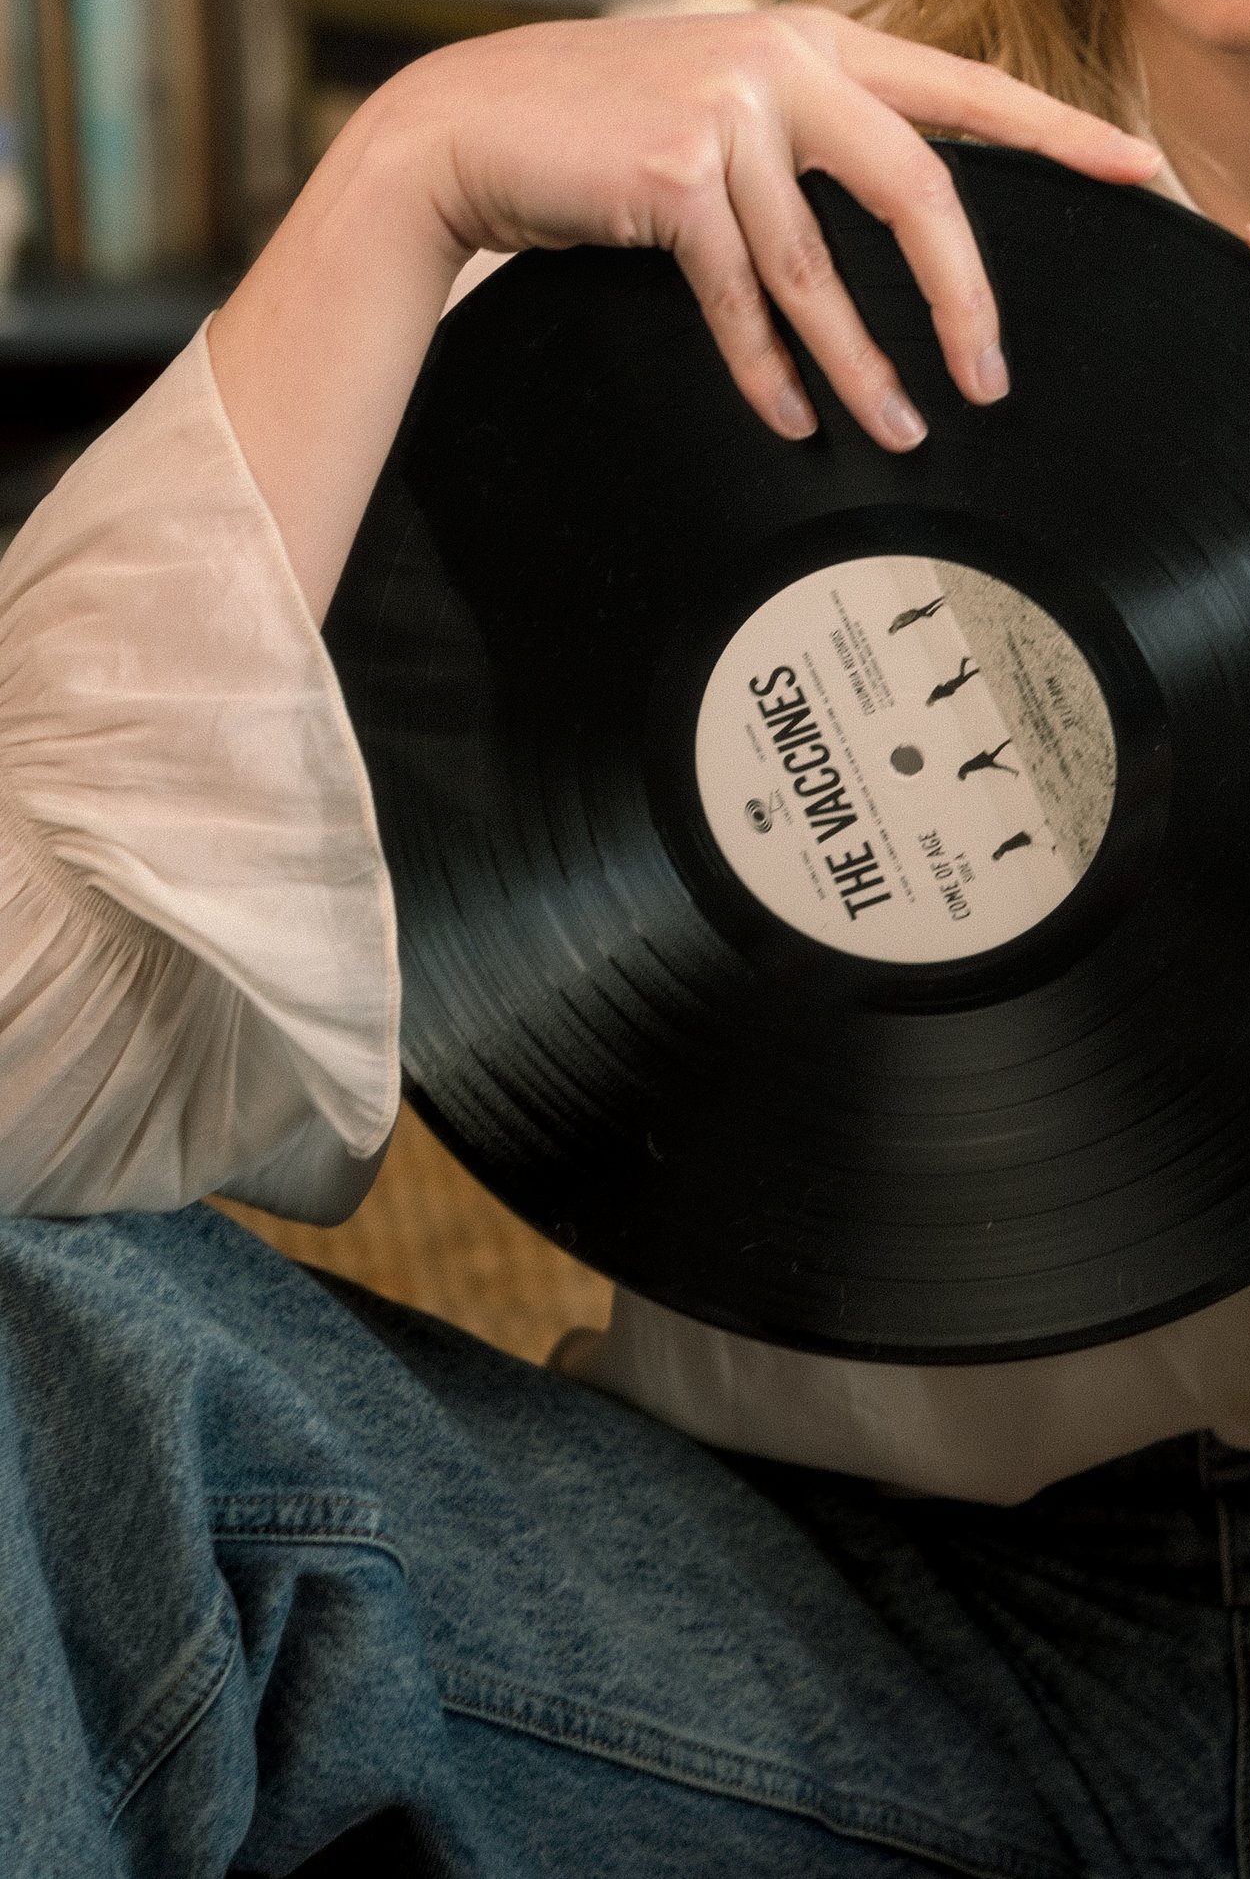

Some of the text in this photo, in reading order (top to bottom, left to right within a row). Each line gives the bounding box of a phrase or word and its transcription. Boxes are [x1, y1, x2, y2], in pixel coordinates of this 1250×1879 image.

[748, 665, 859, 844] VACCINES
[824, 841, 892, 921] THE
[918, 829, 972, 921] COME OF AGE
